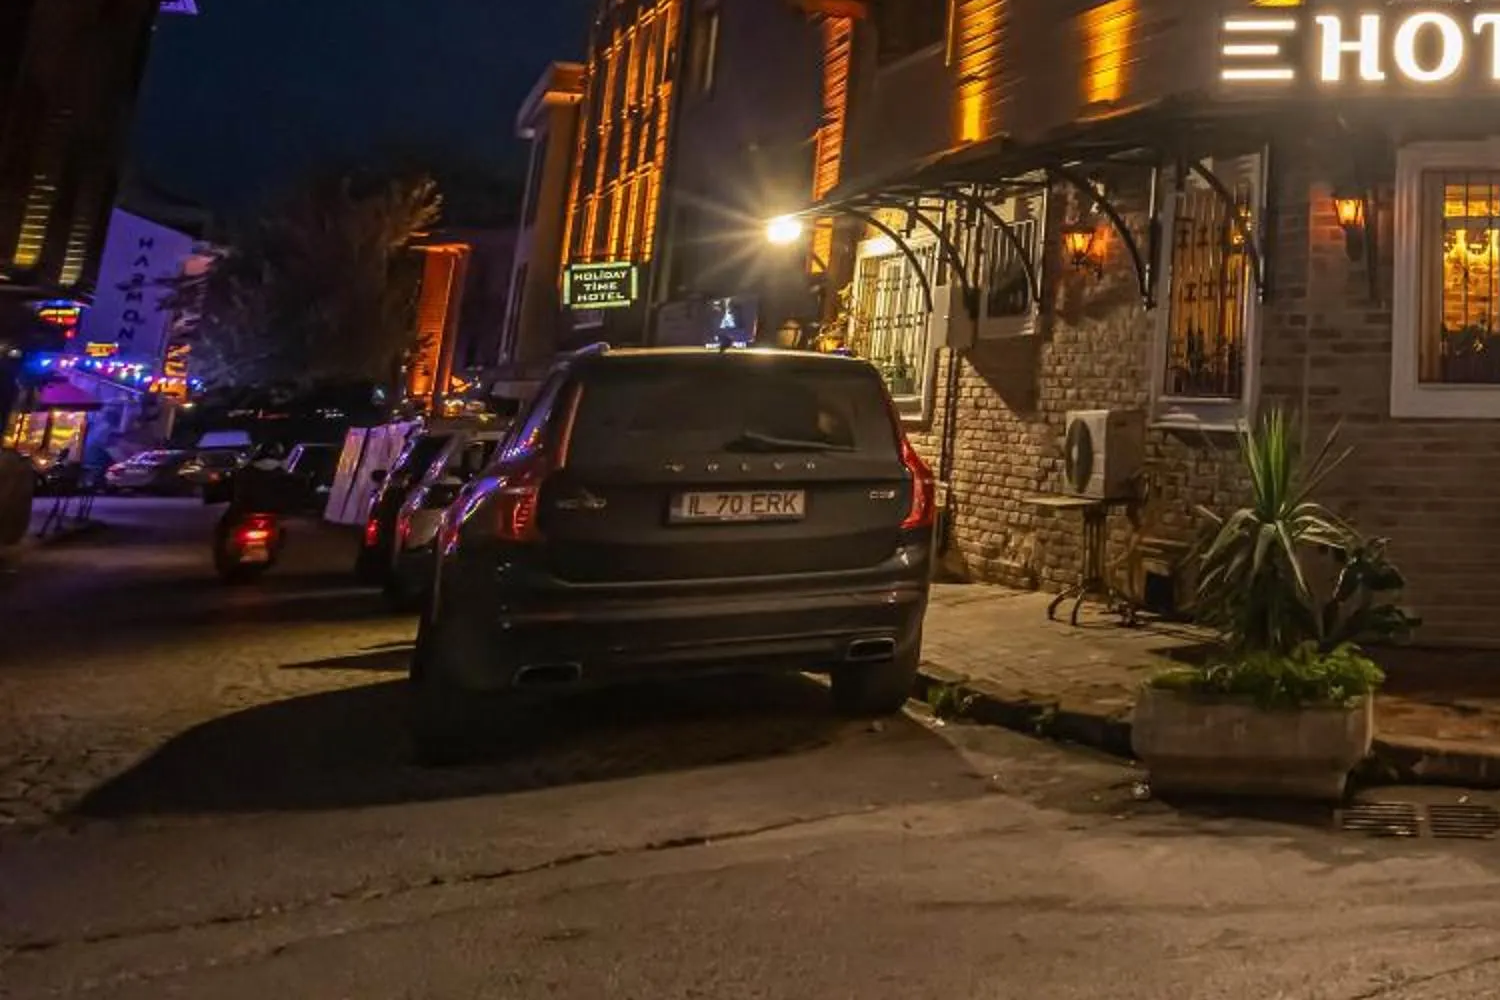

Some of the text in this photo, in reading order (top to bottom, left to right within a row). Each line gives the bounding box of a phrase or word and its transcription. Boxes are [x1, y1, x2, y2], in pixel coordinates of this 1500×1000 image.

[577, 291, 625, 302] HOTEL
[716, 494, 744, 515] 70
[750, 492, 799, 514] ERK
